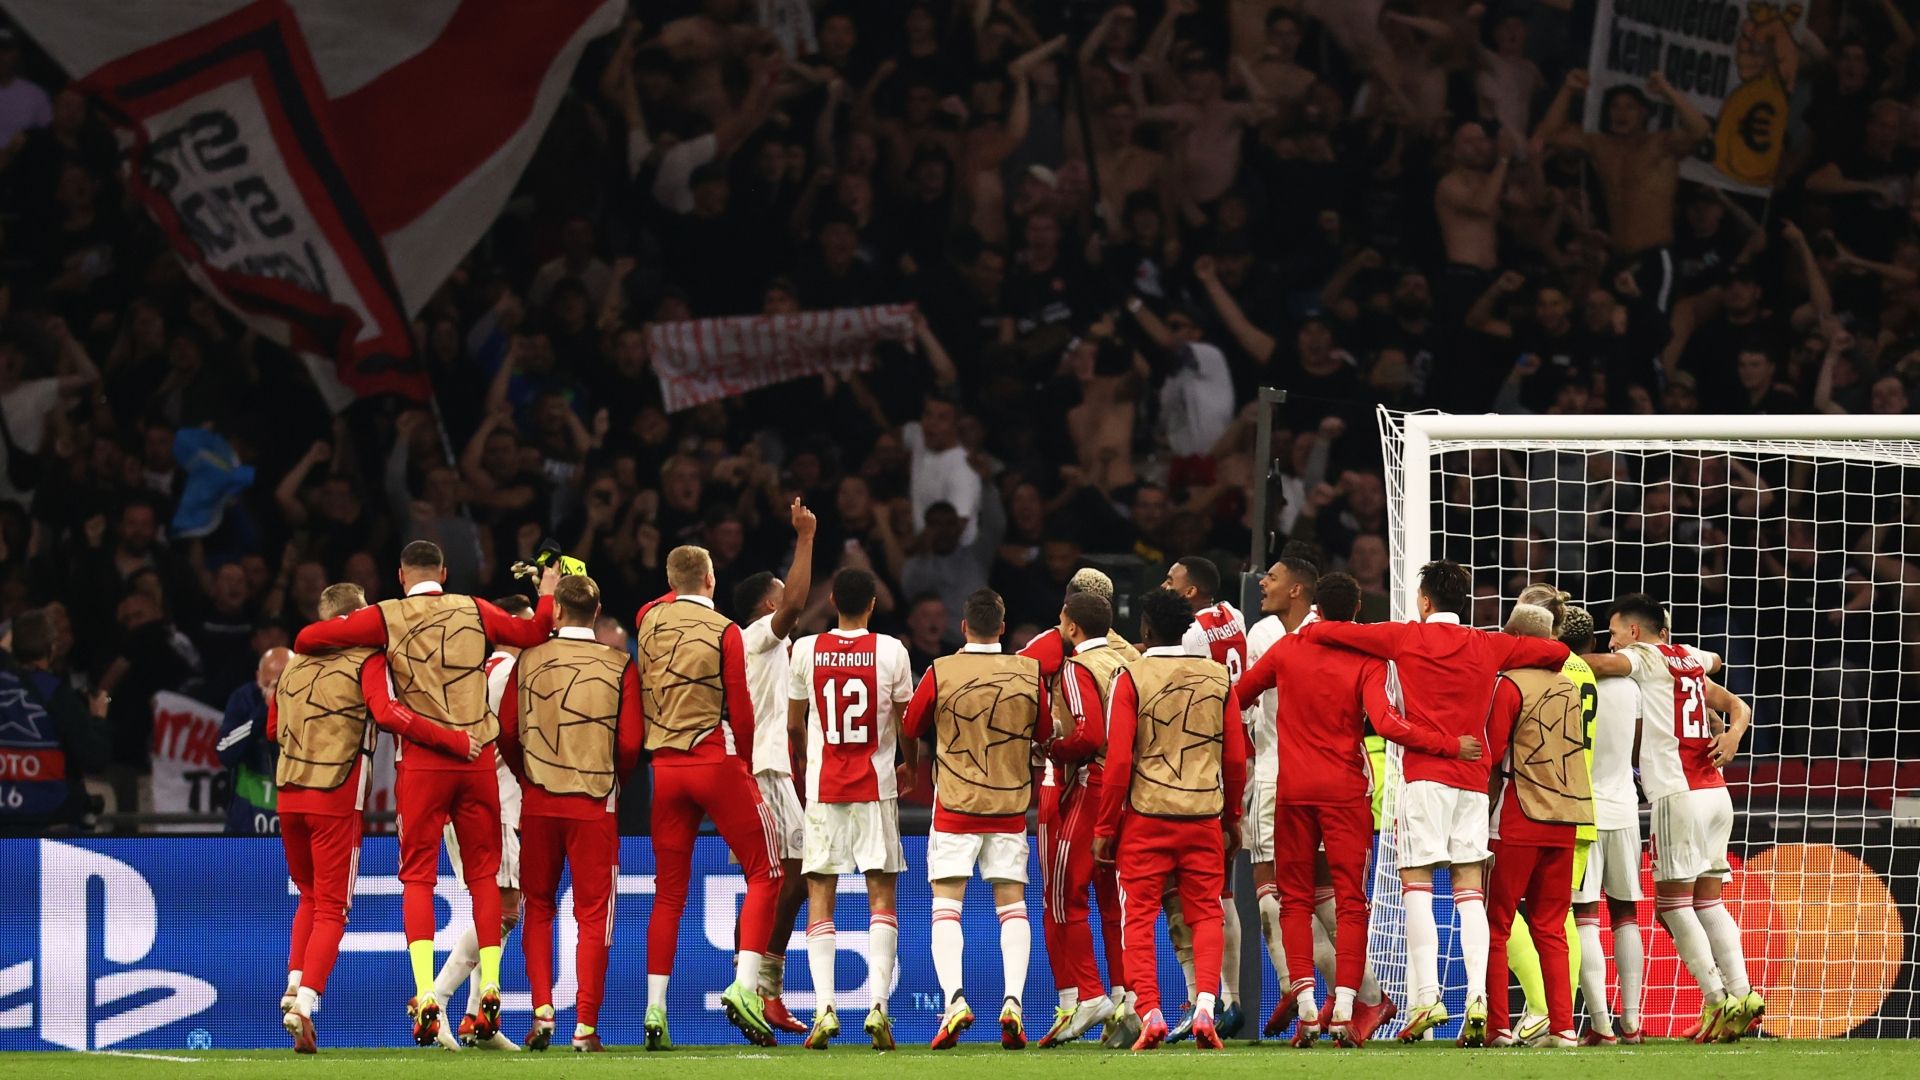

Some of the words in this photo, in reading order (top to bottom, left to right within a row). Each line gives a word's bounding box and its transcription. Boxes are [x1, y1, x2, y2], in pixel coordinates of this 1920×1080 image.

[815, 652, 874, 667] MAZRAOUI
[822, 678, 868, 744] 12
[1680, 676, 1709, 738] 21
